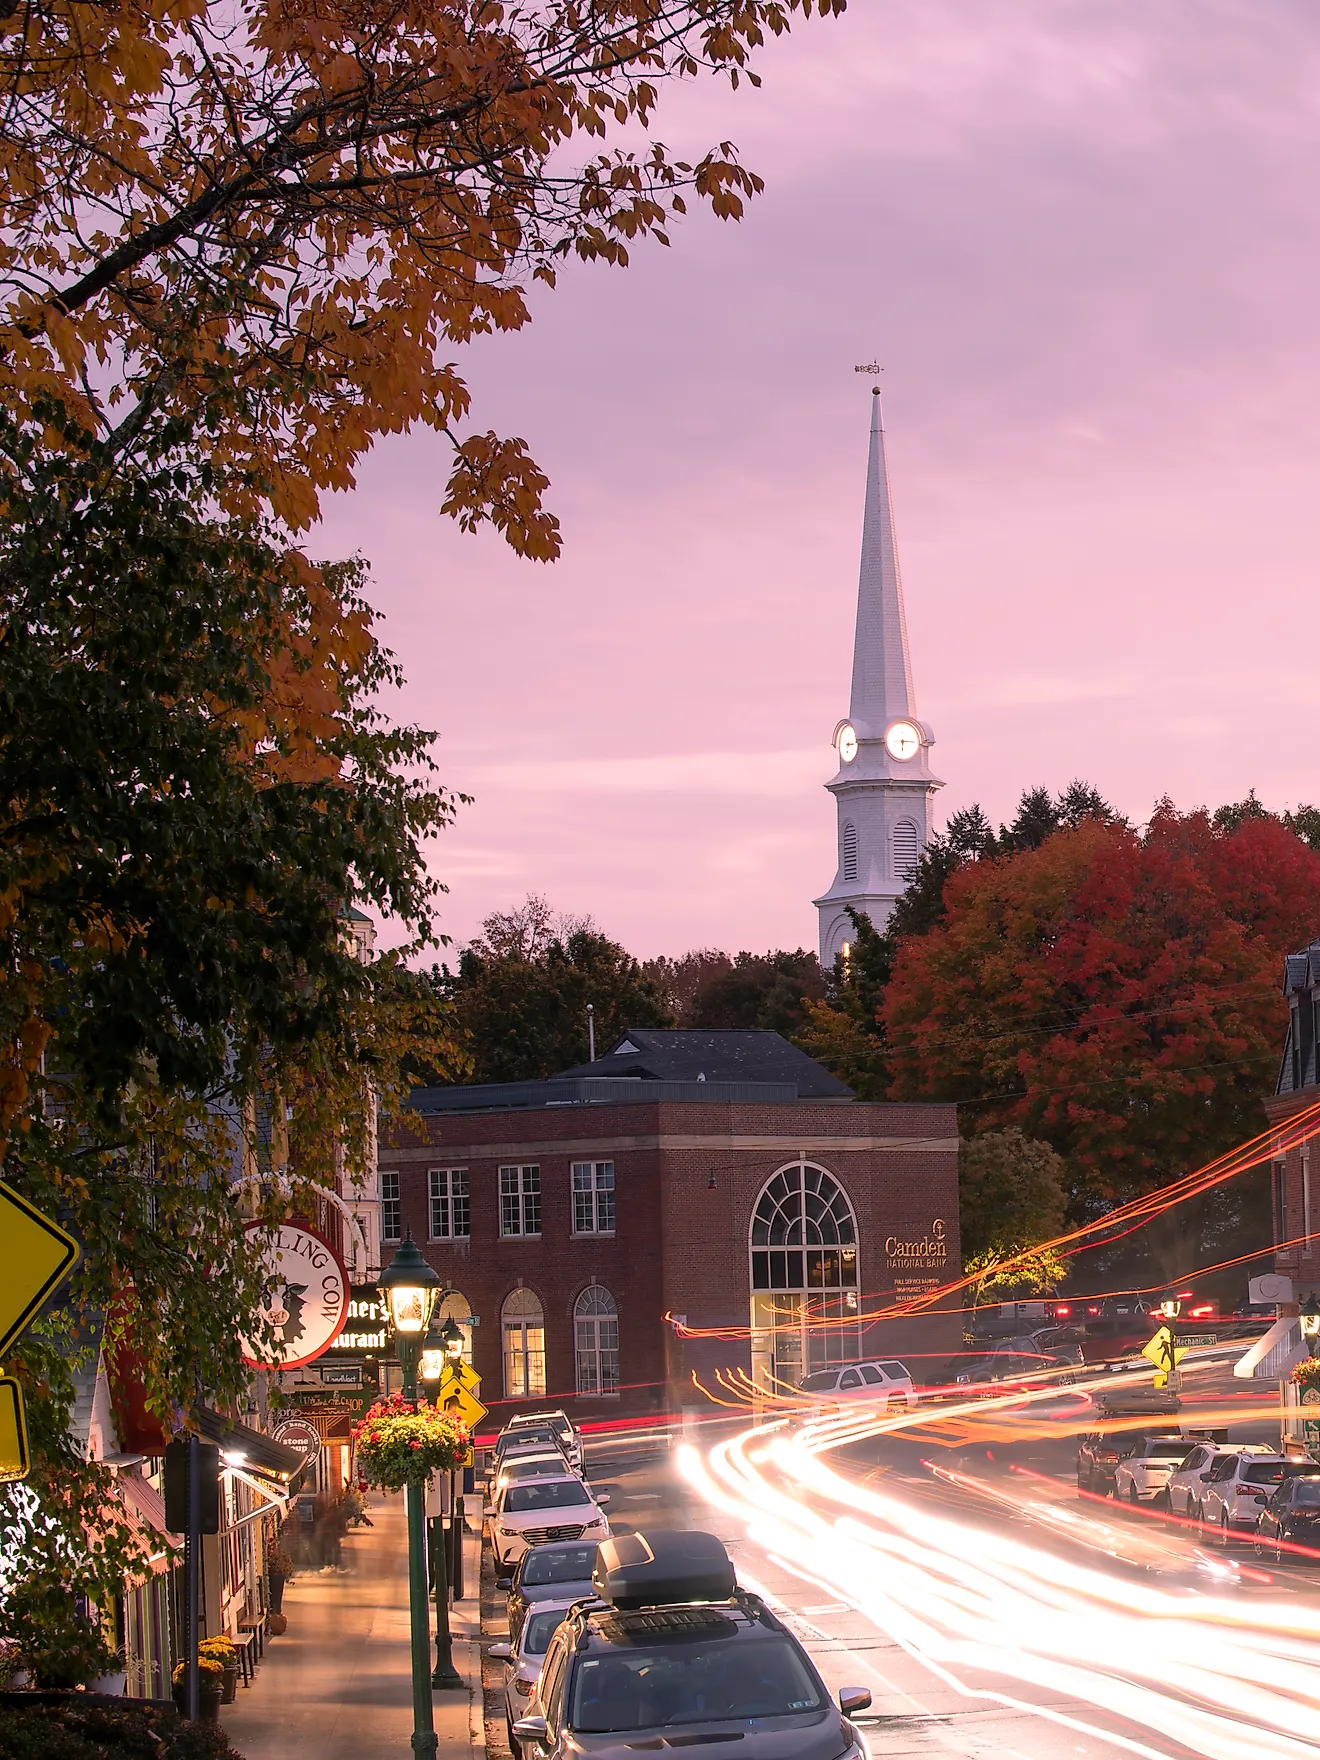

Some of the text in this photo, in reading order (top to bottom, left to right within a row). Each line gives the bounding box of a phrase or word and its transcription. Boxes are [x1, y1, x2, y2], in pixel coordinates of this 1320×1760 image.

[885, 1236, 947, 1257] Camden
[886, 1259, 947, 1268] NATIONAL BANK
[320, 1275, 341, 1324] COW
[1176, 1336, 1216, 1346] Mechanic St
[283, 1437, 309, 1446] stone
